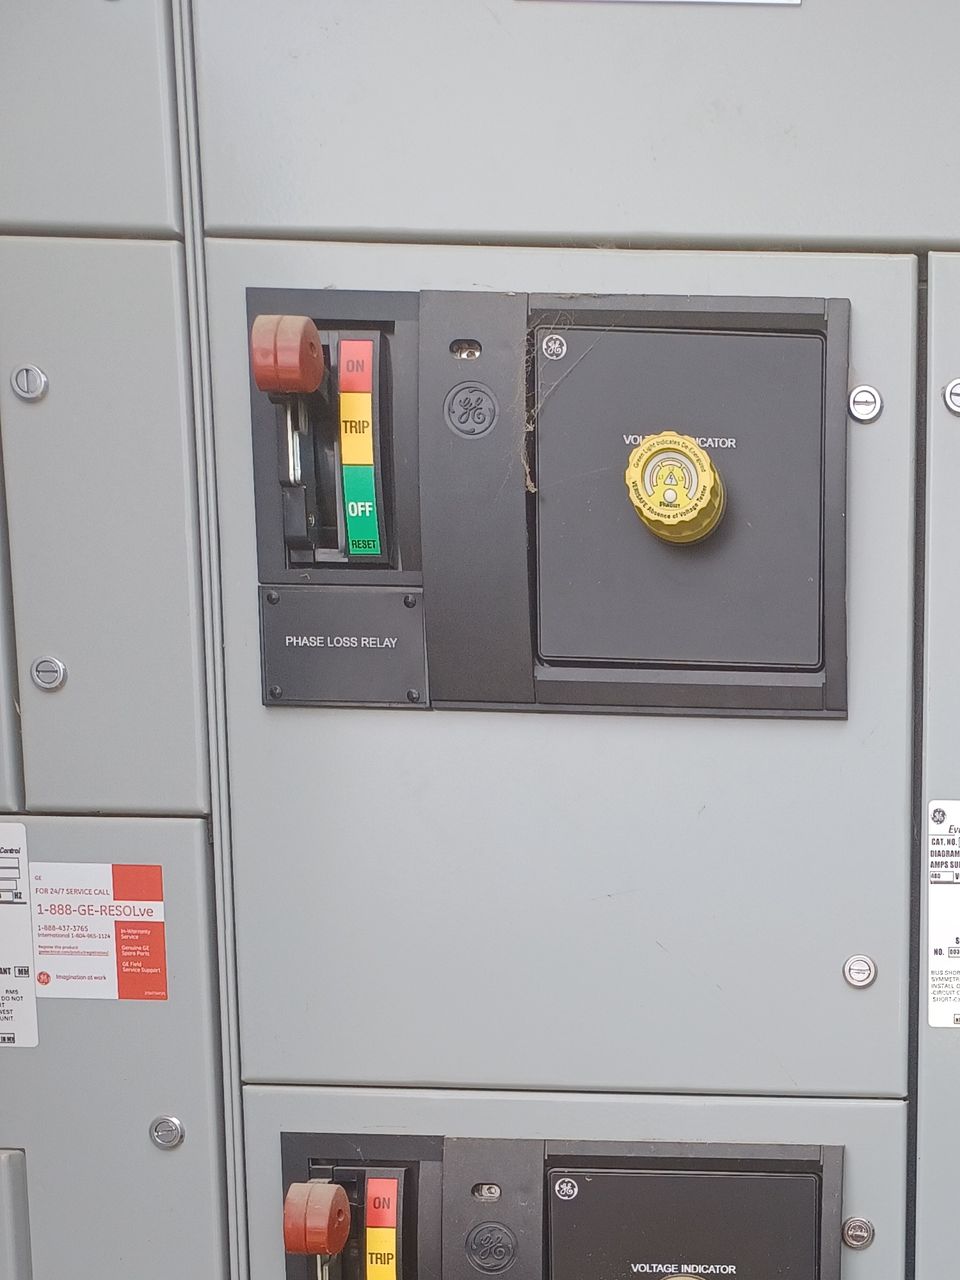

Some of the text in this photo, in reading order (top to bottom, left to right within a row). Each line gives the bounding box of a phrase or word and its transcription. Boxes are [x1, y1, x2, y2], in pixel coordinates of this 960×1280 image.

[346, 359, 365, 373] ON
[342, 420, 370, 434] TRIP
[348, 502, 373, 517] OFF
[351, 539, 376, 550] RESET
[285, 635, 398, 648] PHASE LOSS RELAY
[931, 838, 946, 846] CAT.
[930, 850, 960, 858] DIAGRAM
[930, 861, 949, 869] AMPS
[35, 887, 49, 895] FOR
[65, 888, 93, 896] SERVICE
[93, 888, 110, 896] CALL
[37, 903, 154, 917] 1-888-GE-RESOLve
[933, 948, 945, 956] NO.
[372, 1196, 391, 1210] ON
[368, 1252, 394, 1265] TRIP
[630, 1263, 737, 1274] VOLTAGE INDICATOR
